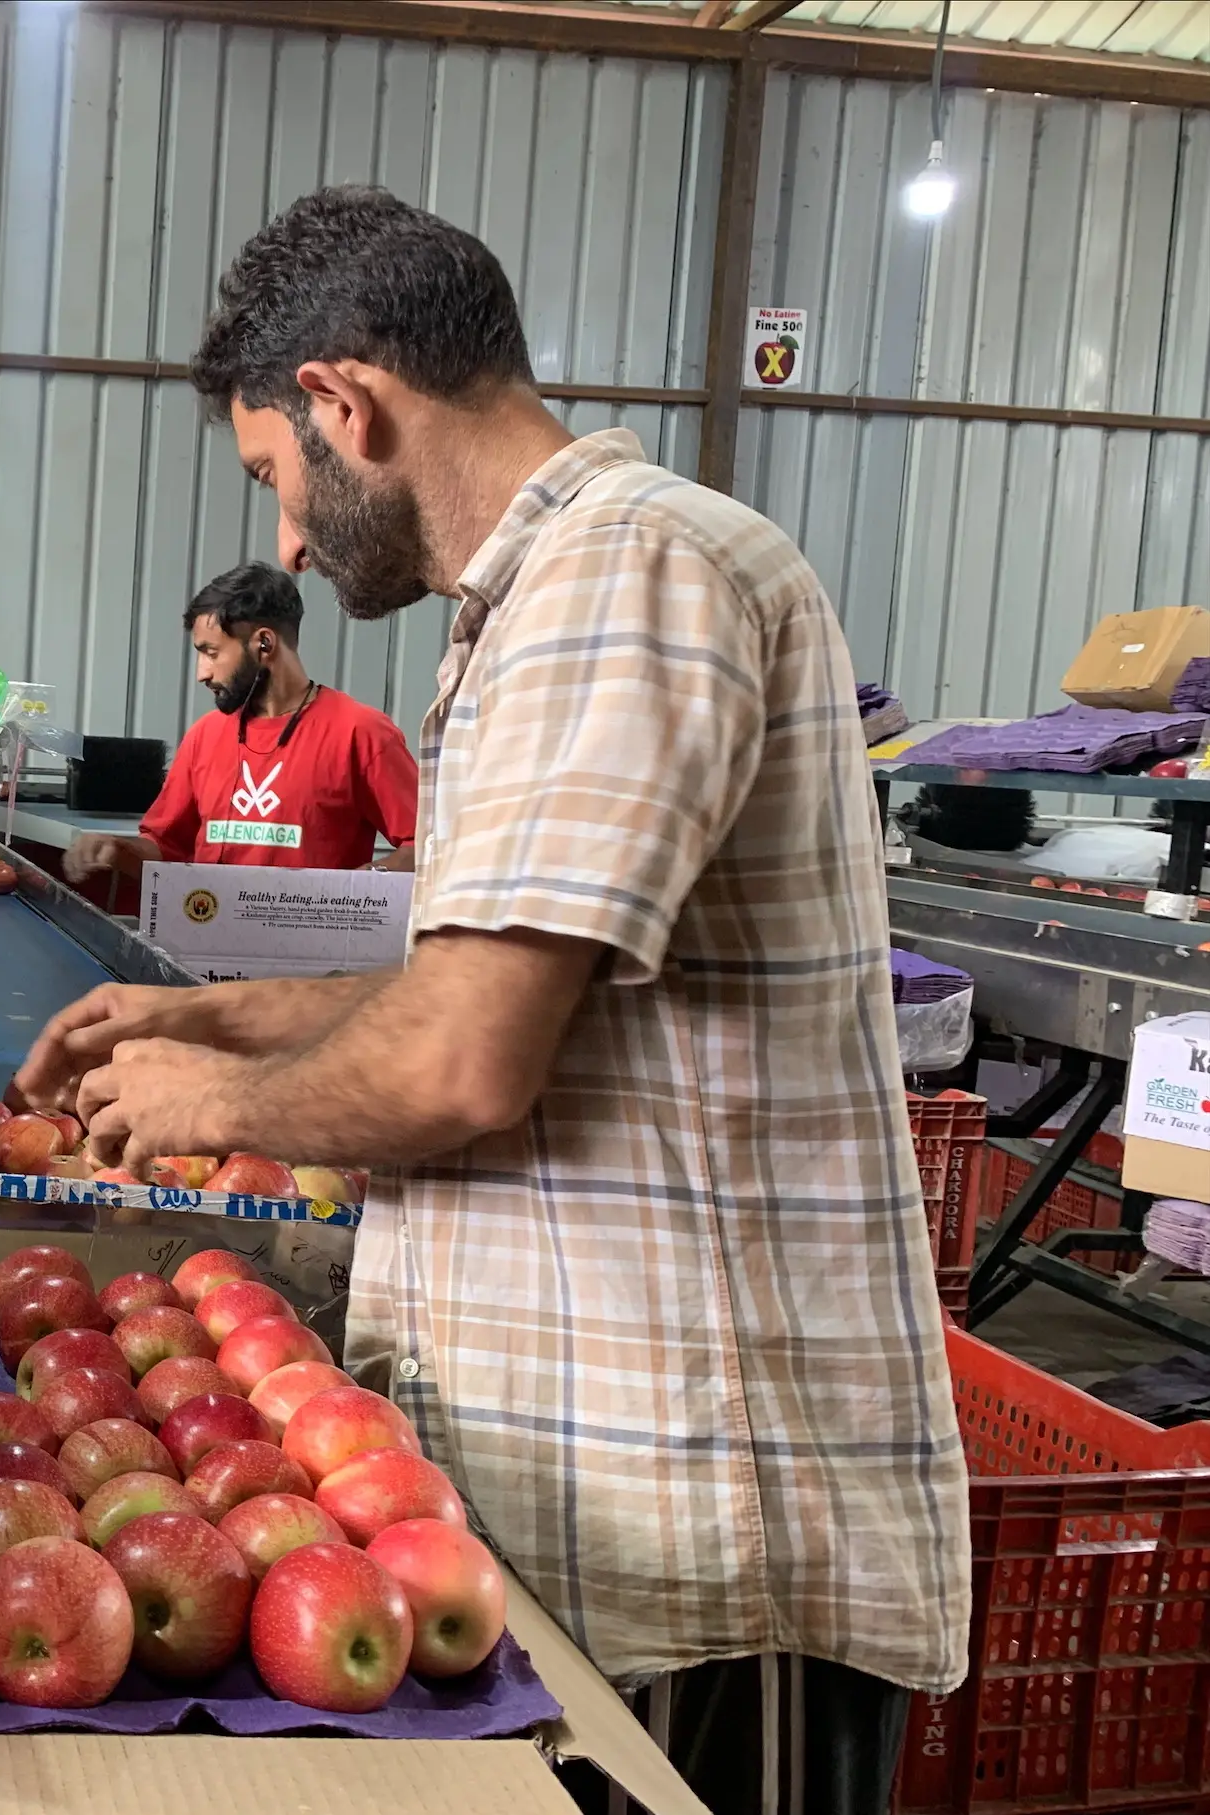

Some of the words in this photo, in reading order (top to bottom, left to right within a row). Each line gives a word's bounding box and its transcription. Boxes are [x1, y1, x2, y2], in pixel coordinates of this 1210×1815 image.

[759, 309, 772, 317] No
[755, 319, 779, 330] Fine
[782, 320, 803, 331] 500
[209, 822, 297, 844] BALENCIAGA
[238, 890, 277, 904] Healthy
[331, 895, 362, 908] eating
[363, 896, 389, 908] fresh
[150, 907, 158, 920] THIS
[1146, 1080, 1199, 1098] GARDEN
[1147, 1093, 1196, 1112] FRESH
[1143, 1111, 1166, 1125] The
[1170, 1116, 1201, 1132] Taste
[944, 1146, 965, 1239] CHAKOORA
